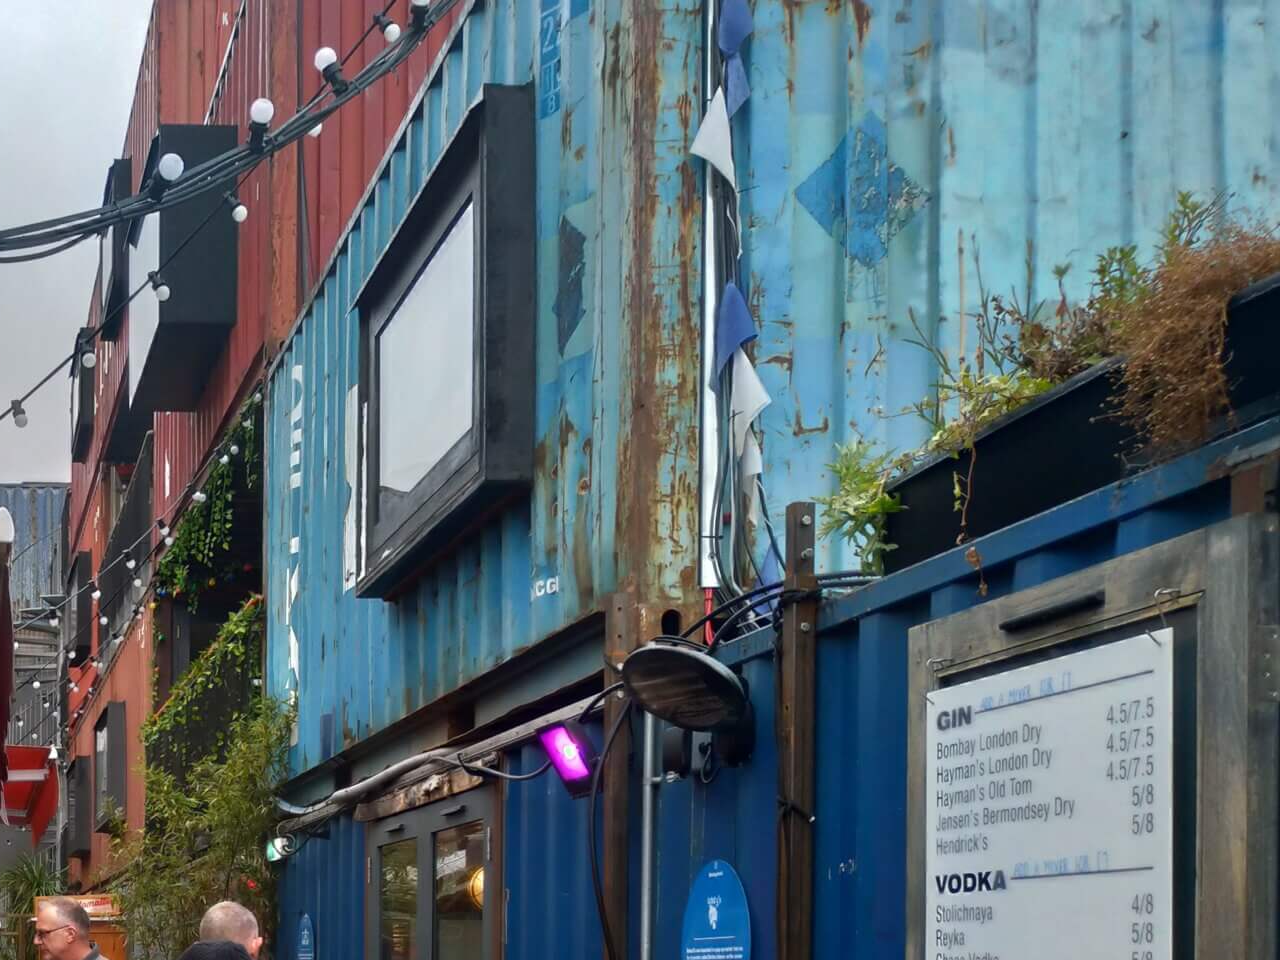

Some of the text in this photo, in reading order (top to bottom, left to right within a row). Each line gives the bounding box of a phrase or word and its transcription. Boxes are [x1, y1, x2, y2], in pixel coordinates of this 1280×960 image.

[937, 706, 972, 730] GIN
[937, 698, 1154, 760] Bombay London Dry 4.5/7.5
[937, 727, 1154, 784] Hayman's London Dry 4.5/7.5
[937, 756, 1154, 809] Hayman's Old Tom 4.5/7.5
[936, 785, 1154, 832] Jensen's Bermondsey Dry 5/8
[936, 813, 1154, 857] Hendrick's 5/8
[936, 870, 1006, 894] VODKA
[936, 894, 1153, 925] Stolichnaya 4/8
[936, 923, 1153, 950] Reyka 5/8
